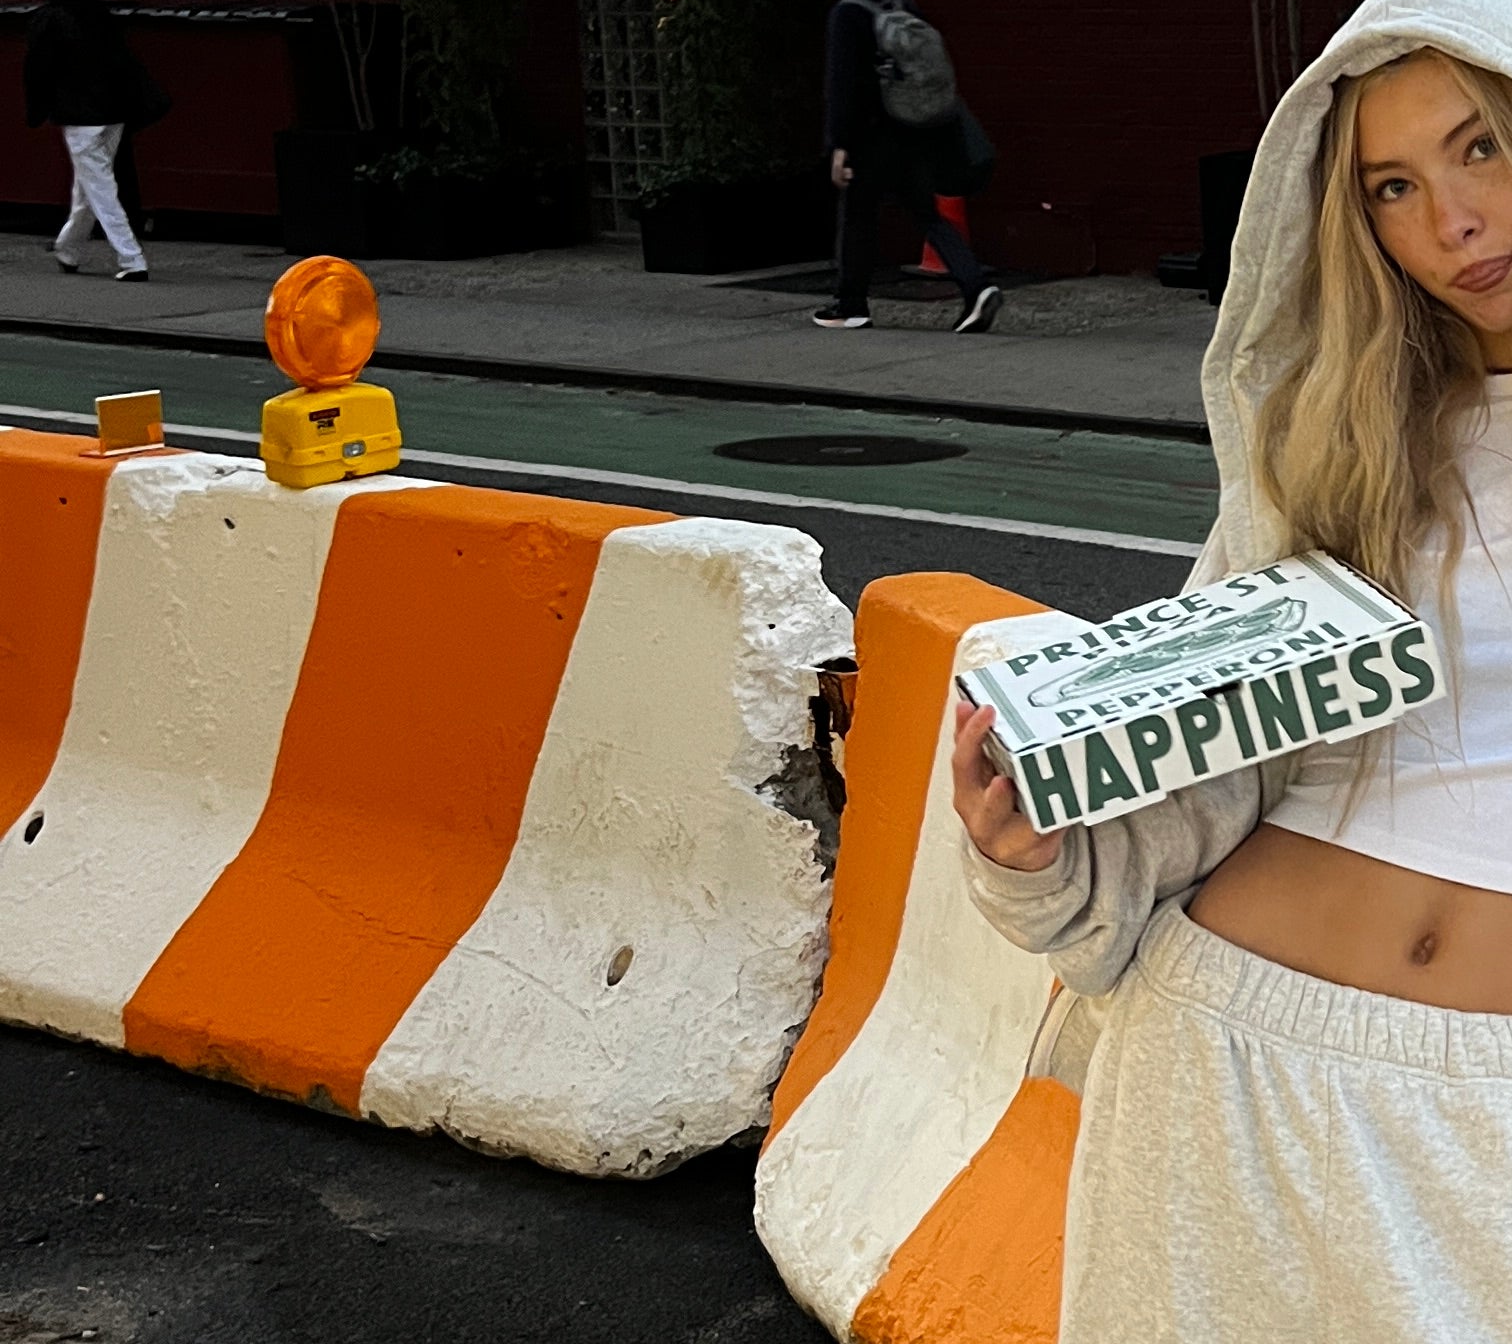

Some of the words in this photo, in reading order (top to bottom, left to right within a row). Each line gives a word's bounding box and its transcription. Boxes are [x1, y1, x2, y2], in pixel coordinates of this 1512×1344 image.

[1006, 592, 1213, 677] PRINCE
[1225, 564, 1305, 597] ST.
[1056, 621, 1346, 727] PEPPERONI
[1018, 626, 1436, 828] HAPPINESS
